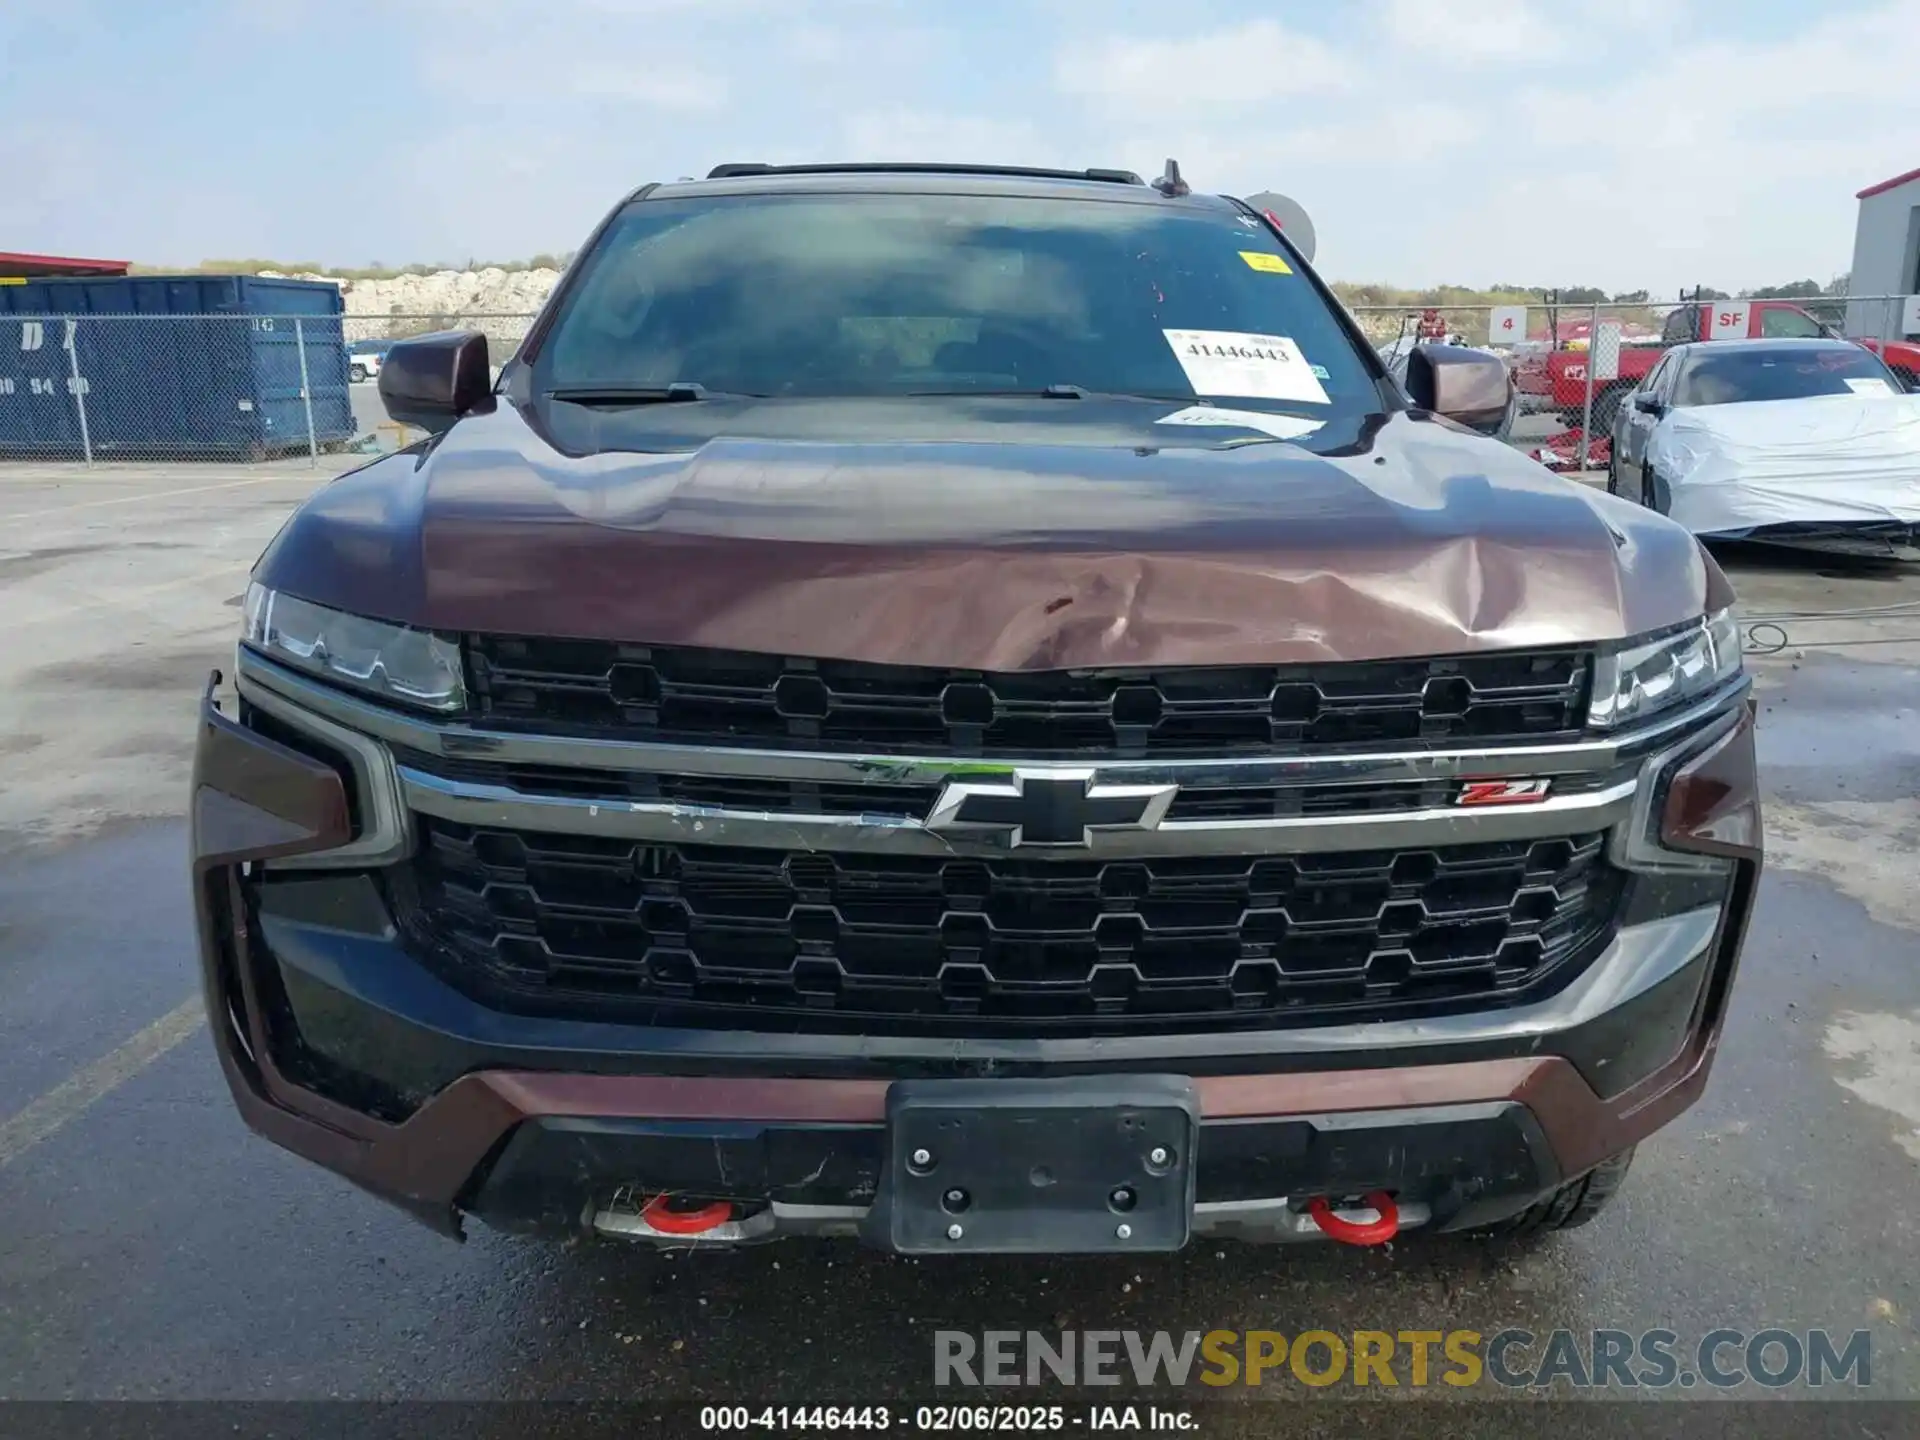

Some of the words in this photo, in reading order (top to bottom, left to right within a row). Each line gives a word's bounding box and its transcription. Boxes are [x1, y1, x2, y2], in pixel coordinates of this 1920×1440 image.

[1503, 318, 1514, 330] 4
[1719, 313, 1743, 326] SF
[1187, 343, 1290, 362] 41446443
[1455, 779, 1551, 806] Z71
